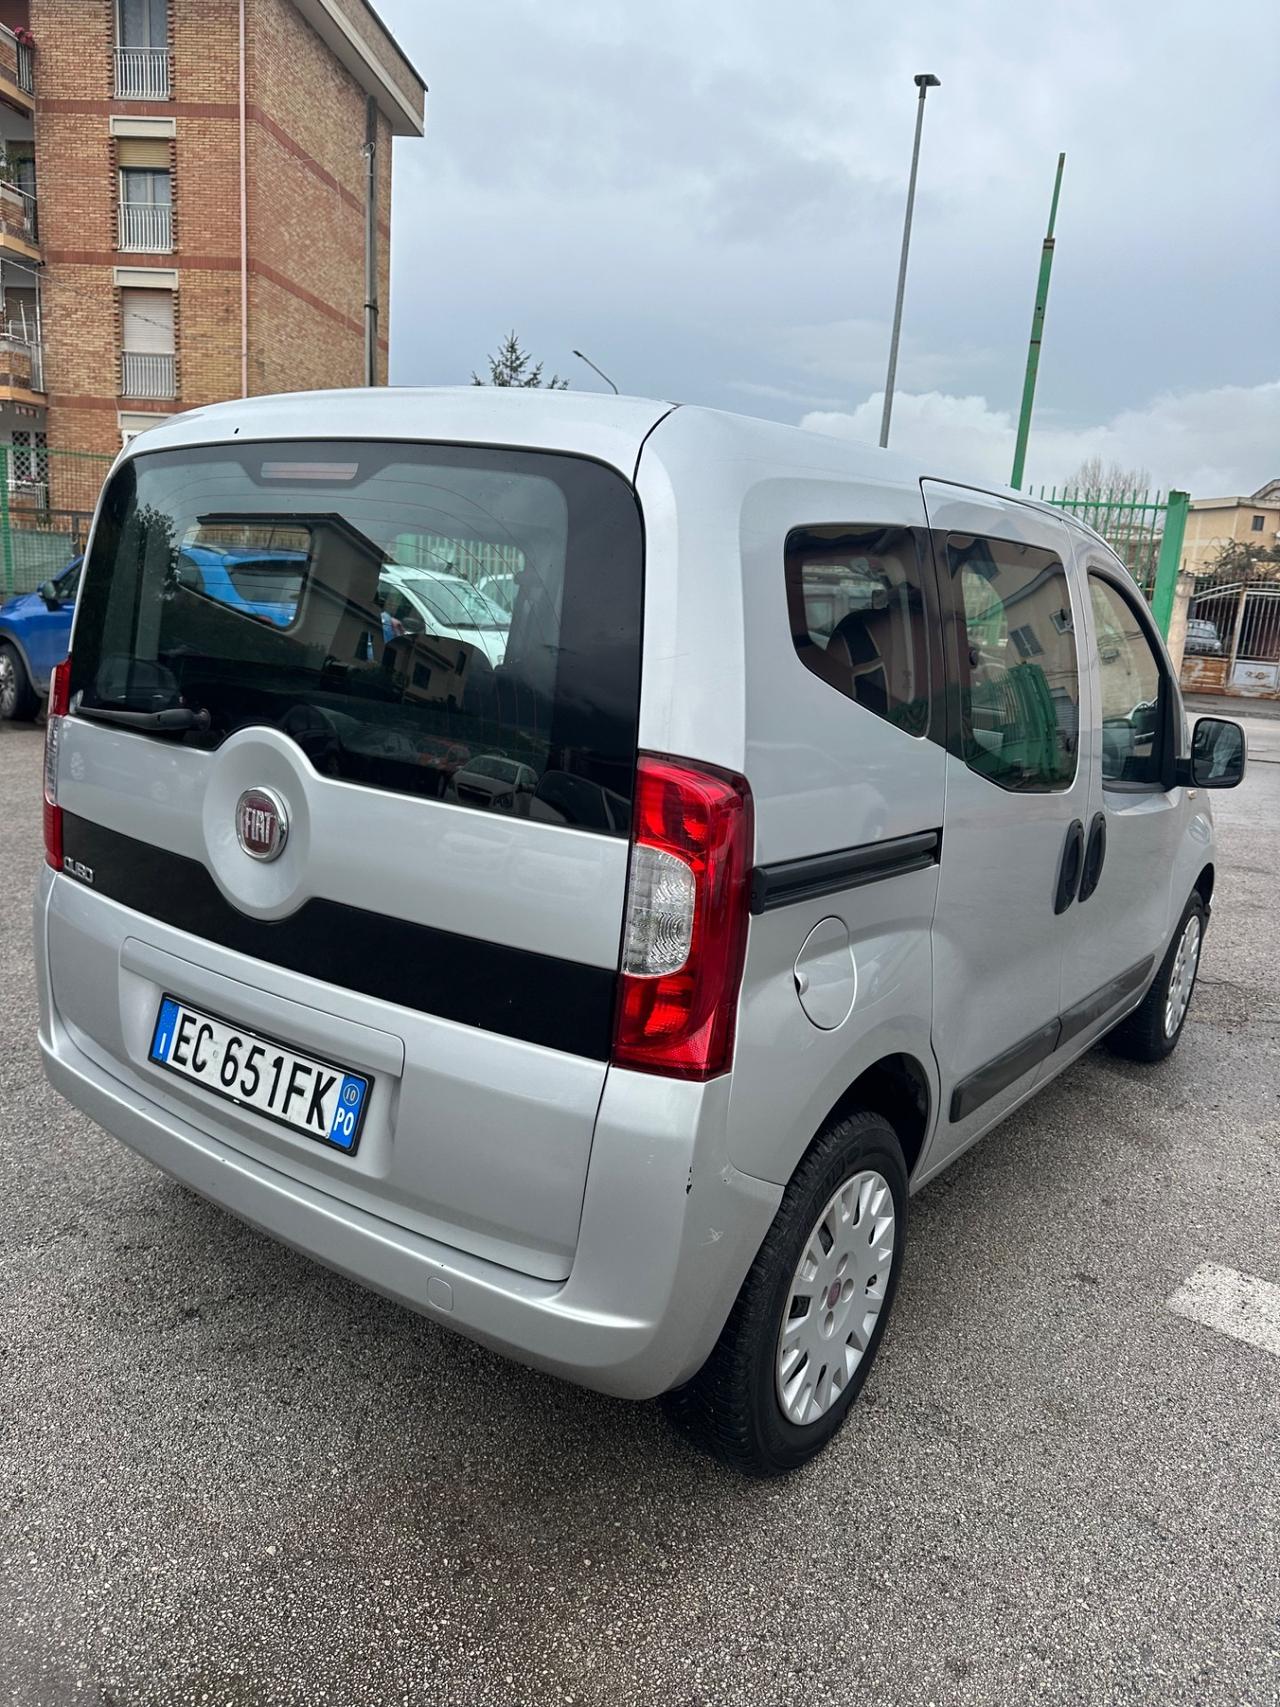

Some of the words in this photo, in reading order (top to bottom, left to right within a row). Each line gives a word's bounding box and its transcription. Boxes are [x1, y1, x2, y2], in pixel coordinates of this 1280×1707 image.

[244, 806, 276, 844] FIAT
[159, 1032, 167, 1054] I
[172, 1013, 214, 1073] EC
[220, 1036, 337, 1131] 651FK
[345, 1087, 357, 1102] 10
[333, 1106, 355, 1137] PO
